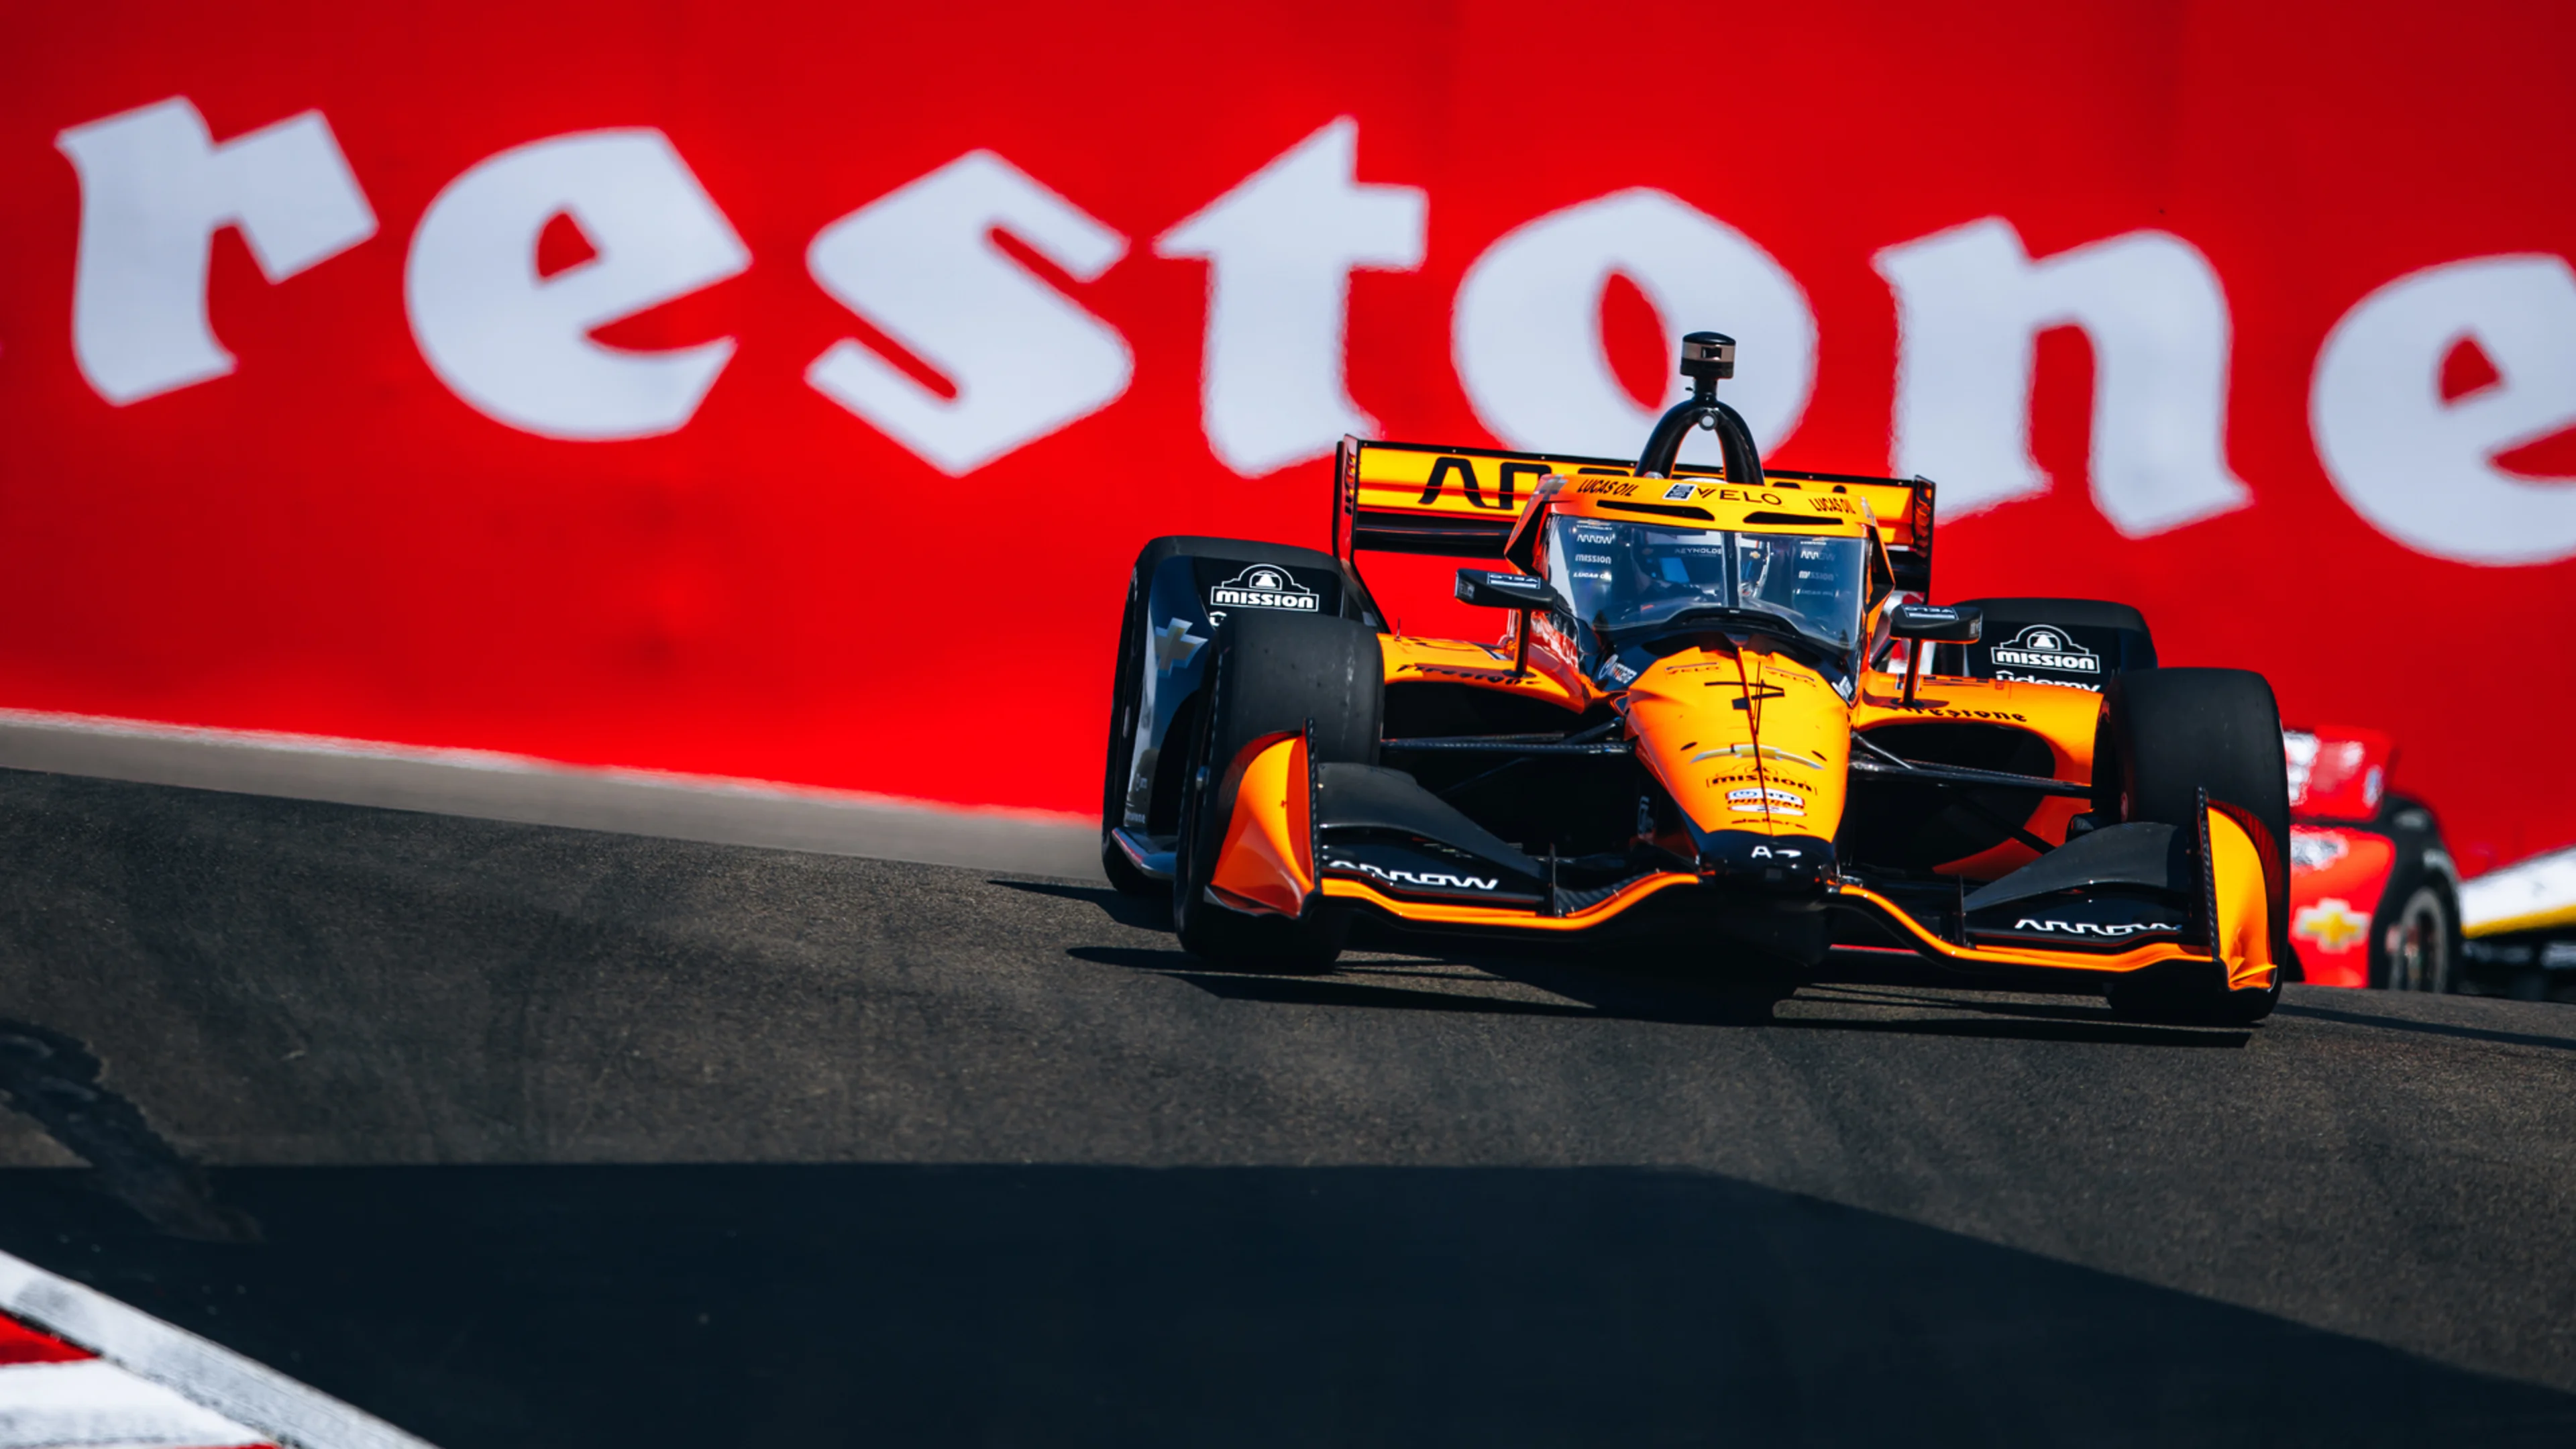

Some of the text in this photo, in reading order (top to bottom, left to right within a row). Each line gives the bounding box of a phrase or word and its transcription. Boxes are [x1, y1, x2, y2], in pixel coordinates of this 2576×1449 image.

[1576, 479, 1639, 497] LUCAS OIL
[1697, 487, 1782, 505] VELO
